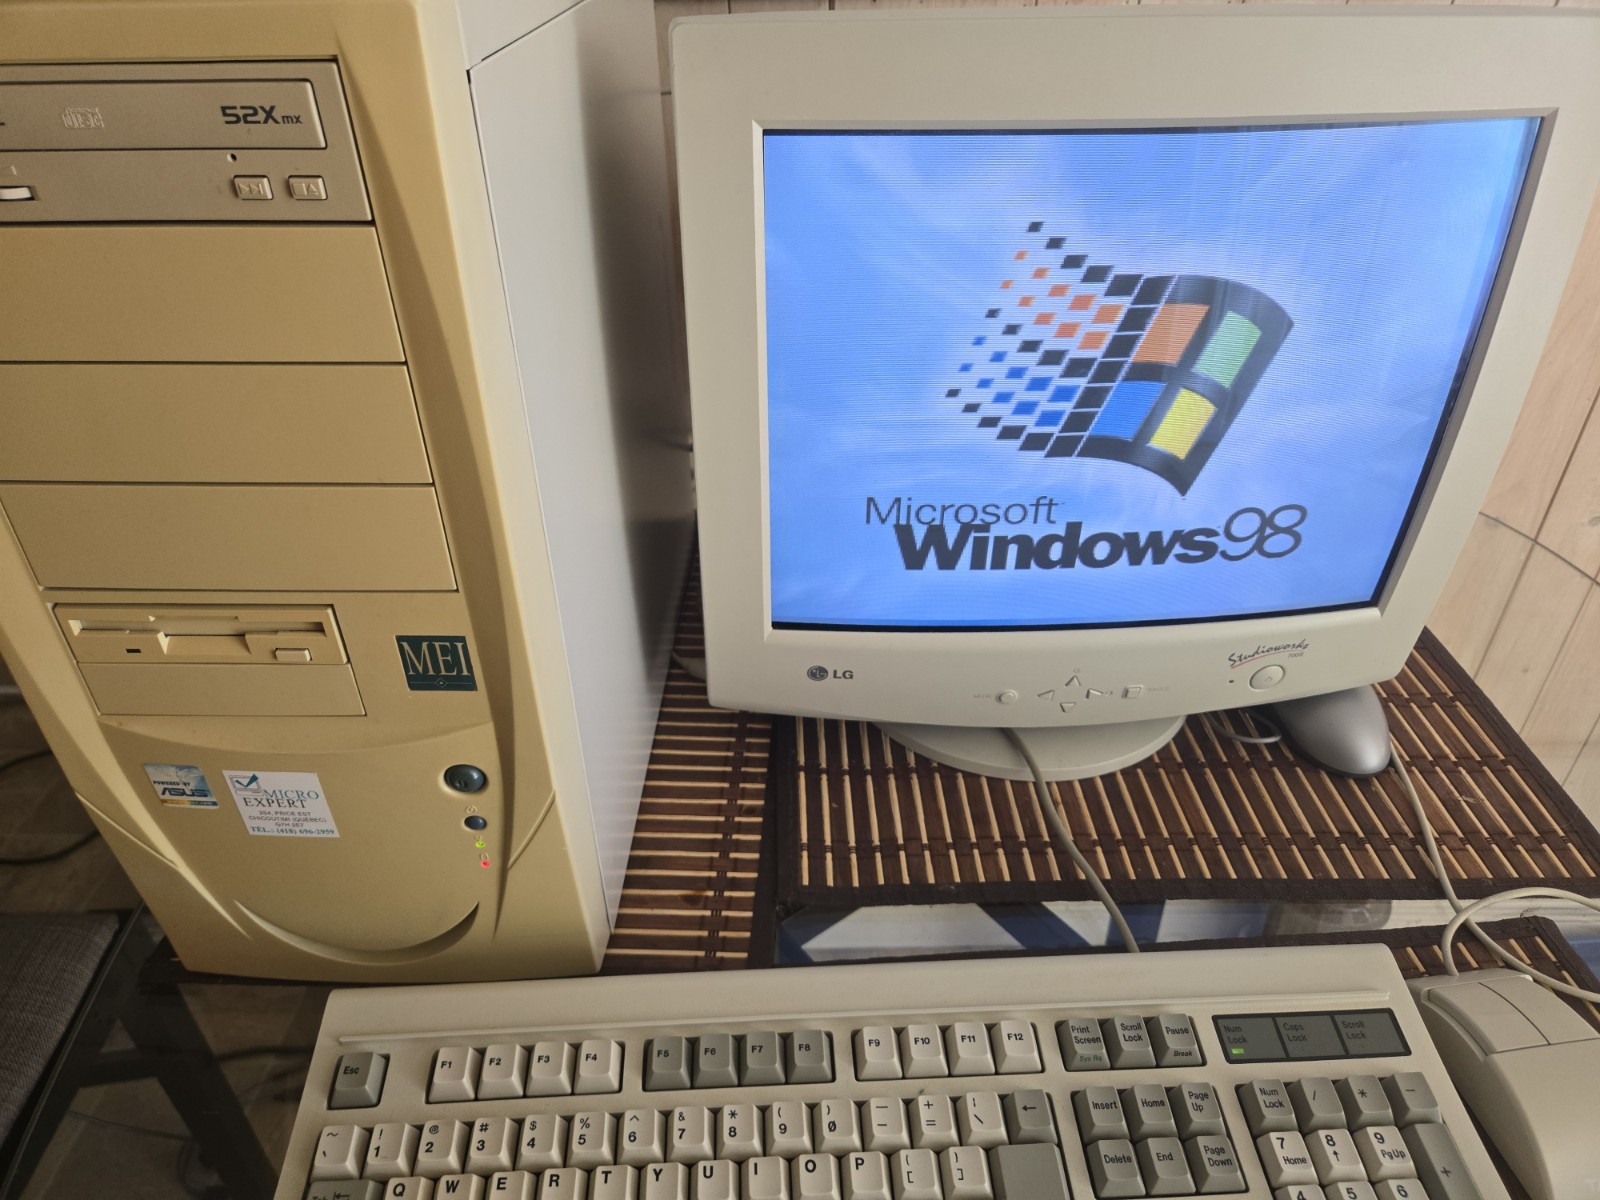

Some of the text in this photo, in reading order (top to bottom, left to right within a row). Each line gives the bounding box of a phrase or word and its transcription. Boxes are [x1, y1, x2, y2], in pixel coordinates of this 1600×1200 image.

[865, 496, 1058, 526] Microsoft
[894, 504, 1308, 570] Windows 98
[400, 641, 472, 676] MEI
[832, 669, 854, 680] LG
[161, 787, 209, 798] ASUS
[263, 789, 319, 800] MICRO
[242, 797, 308, 808] EXPERT
[1071, 1025, 1090, 1034] Print
[1120, 1022, 1142, 1030] Scroll
[1224, 1024, 1242, 1033] Num
[1342, 1020, 1365, 1029] Scroll
[1165, 1026, 1190, 1035] Pause
[1346, 1031, 1366, 1040] Lock
[914, 1036, 930, 1046] F10
[960, 1034, 976, 1043] F11
[1007, 1032, 1024, 1042] F12
[1074, 1036, 1102, 1044] Screen
[1122, 1034, 1144, 1042] Lock
[1228, 1036, 1248, 1044] Lock
[1287, 1033, 1308, 1042] Lock
[798, 1043, 811, 1052] F8
[868, 1038, 881, 1047] F9
[656, 1049, 670, 1058] F5
[704, 1047, 716, 1056] F6
[751, 1044, 764, 1054] F7
[488, 1057, 502, 1066] F2
[536, 1054, 550, 1064] F3
[584, 1052, 598, 1062] F4
[440, 1060, 453, 1069] F1
[343, 1066, 360, 1075] Esc
[1188, 1090, 1210, 1101] Page
[1260, 1086, 1279, 1096] Num
[1092, 1100, 1118, 1110] Insert
[1141, 1098, 1166, 1108] Home
[1192, 1102, 1204, 1113] Up
[1264, 1099, 1285, 1108] Lock
[728, 1126, 737, 1138] 8
[778, 1122, 788, 1135] 9
[628, 1131, 638, 1144] 6
[678, 1128, 686, 1140] 7
[1374, 1132, 1385, 1145] 9
[526, 1136, 536, 1150] 4
[577, 1134, 587, 1146] 5
[1276, 1137, 1286, 1150] 7
[1325, 1134, 1336, 1147] 8
[424, 1142, 434, 1154] 2
[476, 1139, 486, 1152] 3
[1203, 1146, 1226, 1156] Page
[1104, 1154, 1132, 1164] Delete
[1156, 1152, 1174, 1162] End
[1208, 1157, 1233, 1167] Down
[1282, 1155, 1308, 1165] Home
[804, 1159, 817, 1174] O
[855, 1157, 865, 1171] P
[602, 1170, 612, 1184] T
[652, 1168, 663, 1182] Y
[702, 1166, 714, 1180] U
[496, 1177, 508, 1191] E
[548, 1174, 560, 1188] R
[393, 1182, 406, 1198] Q
[446, 1180, 460, 1194] W
[1396, 1184, 1408, 1198] 6
[1345, 1187, 1358, 1200] 5
